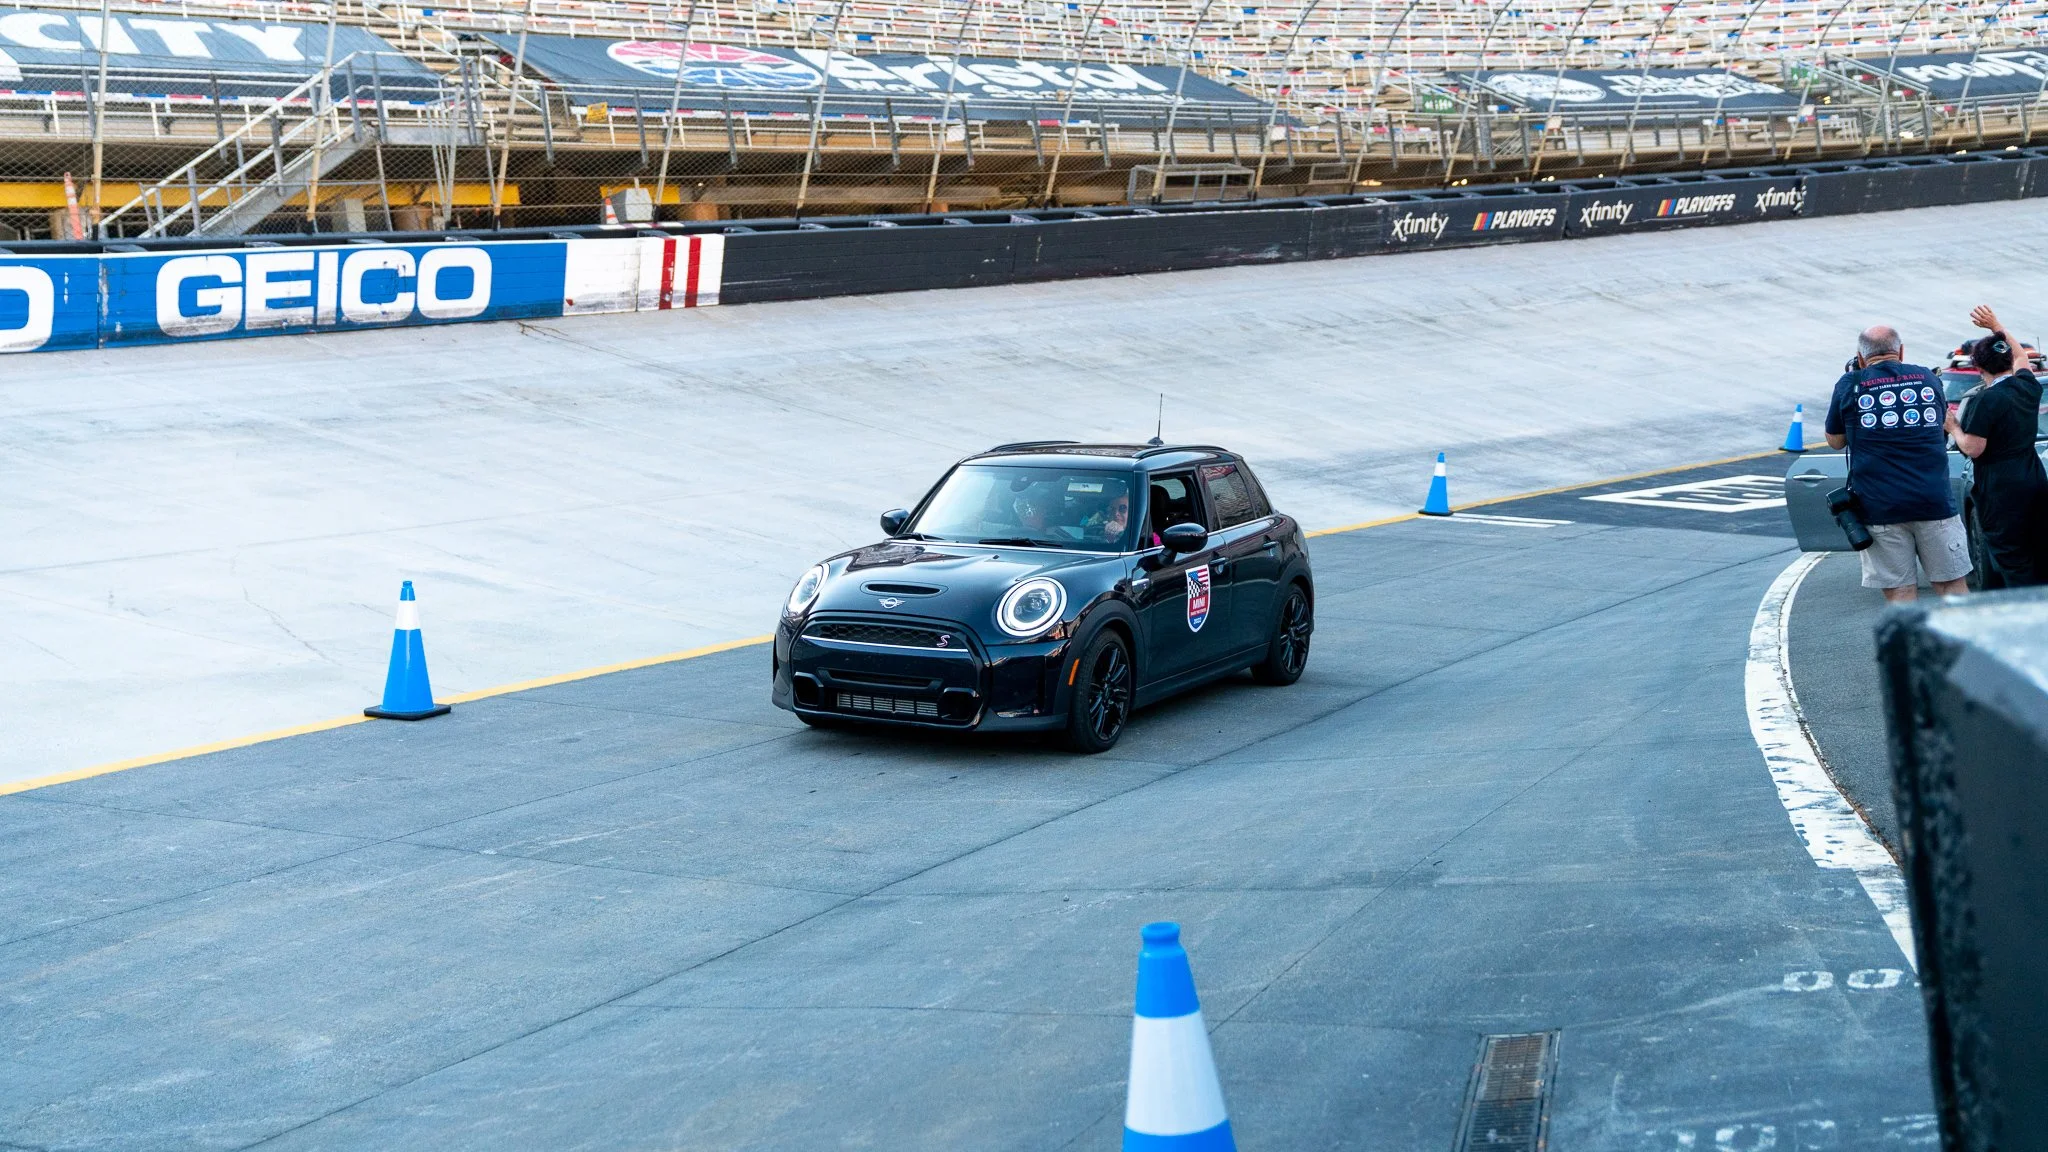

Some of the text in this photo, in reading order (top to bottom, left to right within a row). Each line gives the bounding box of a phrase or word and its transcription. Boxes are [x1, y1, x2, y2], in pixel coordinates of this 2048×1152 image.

[0, 13, 305, 61] CITY
[794, 48, 1169, 91] Bristol
[1391, 186, 1807, 241] xfinity PLAYOFFS xfinity PLAYOFFS xfinity
[156, 247, 493, 337] GEICO
[936, 634, 951, 648] S
